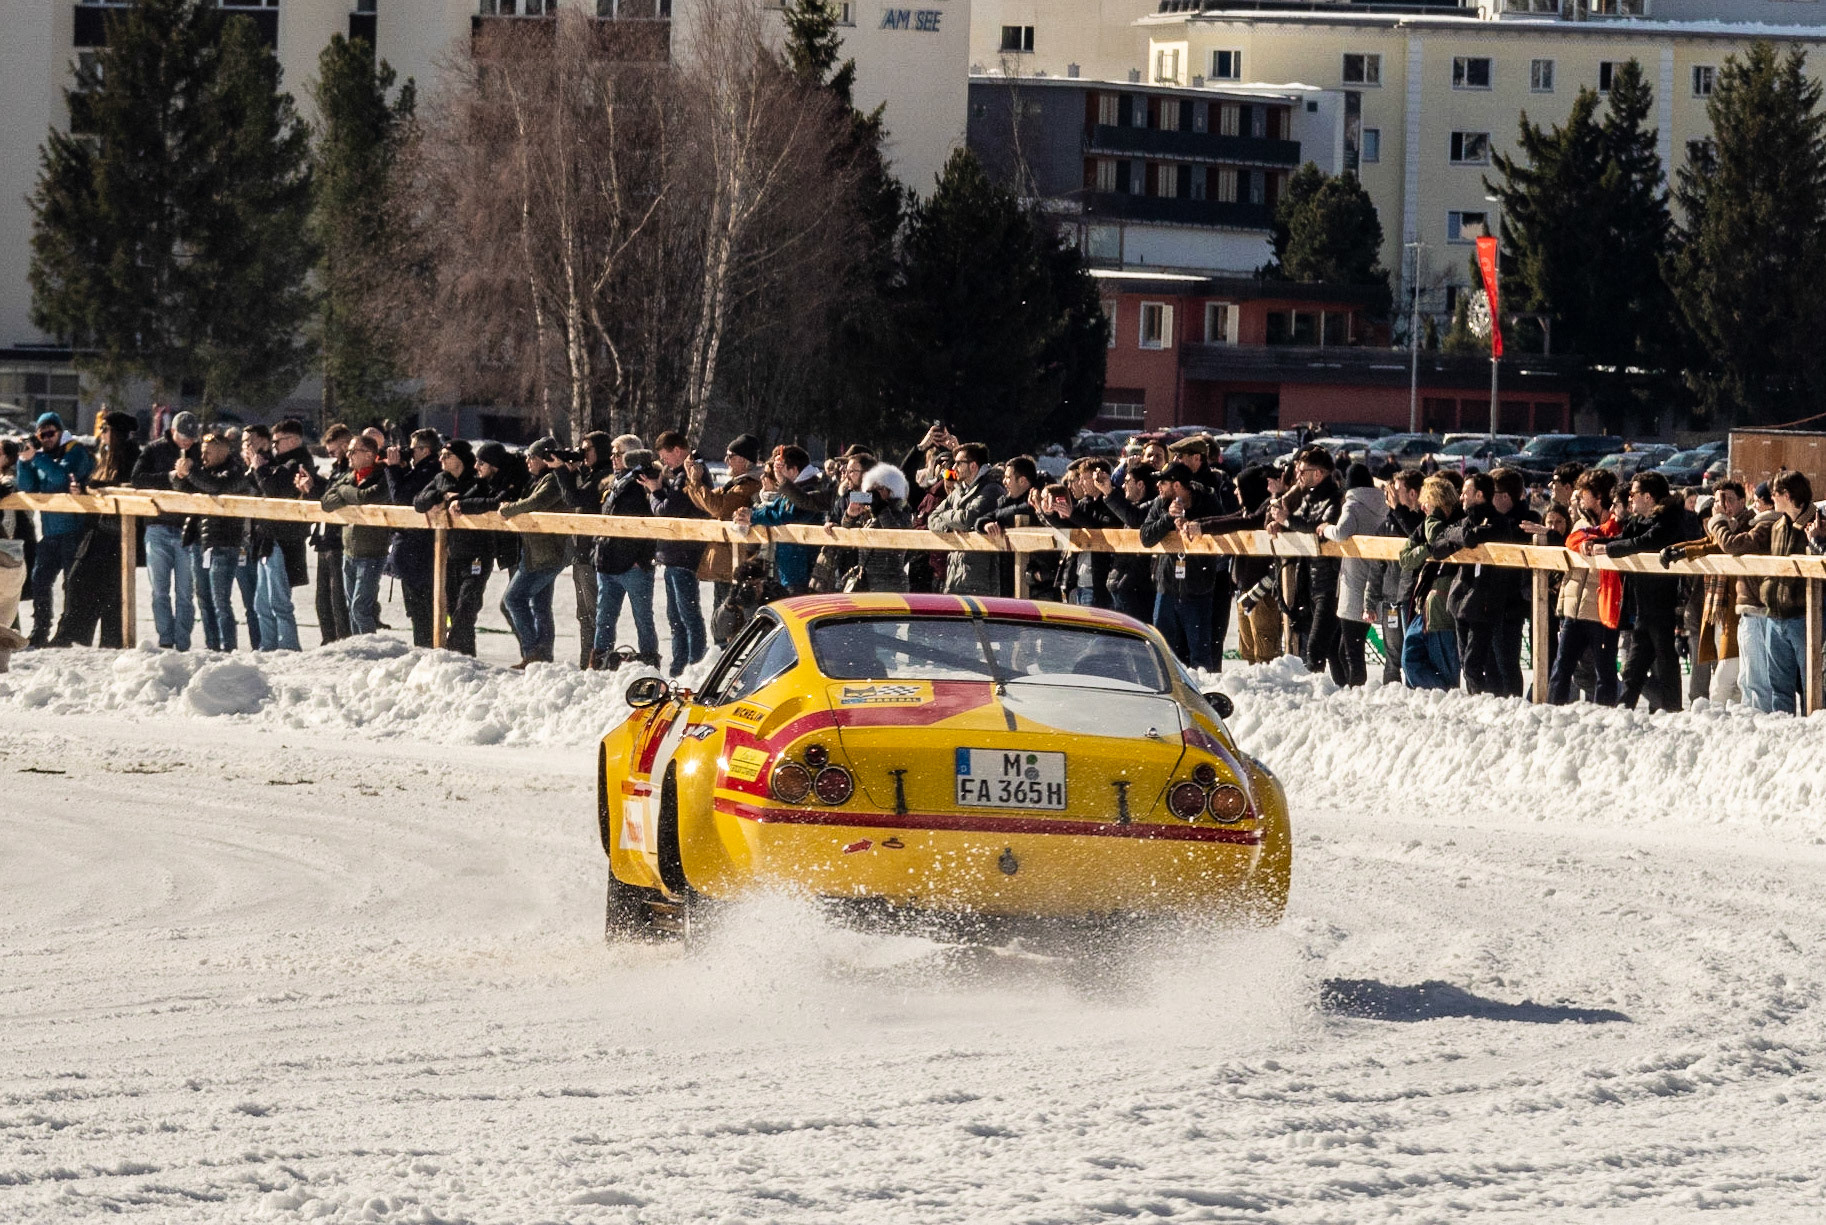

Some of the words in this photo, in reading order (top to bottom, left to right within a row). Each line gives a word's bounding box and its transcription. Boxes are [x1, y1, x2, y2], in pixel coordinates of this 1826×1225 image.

[883, 8, 911, 30] AM
[915, 10, 943, 32] SEE
[731, 706, 766, 722] MICHELIN
[1003, 753, 1021, 777] M
[960, 778, 992, 802] FA
